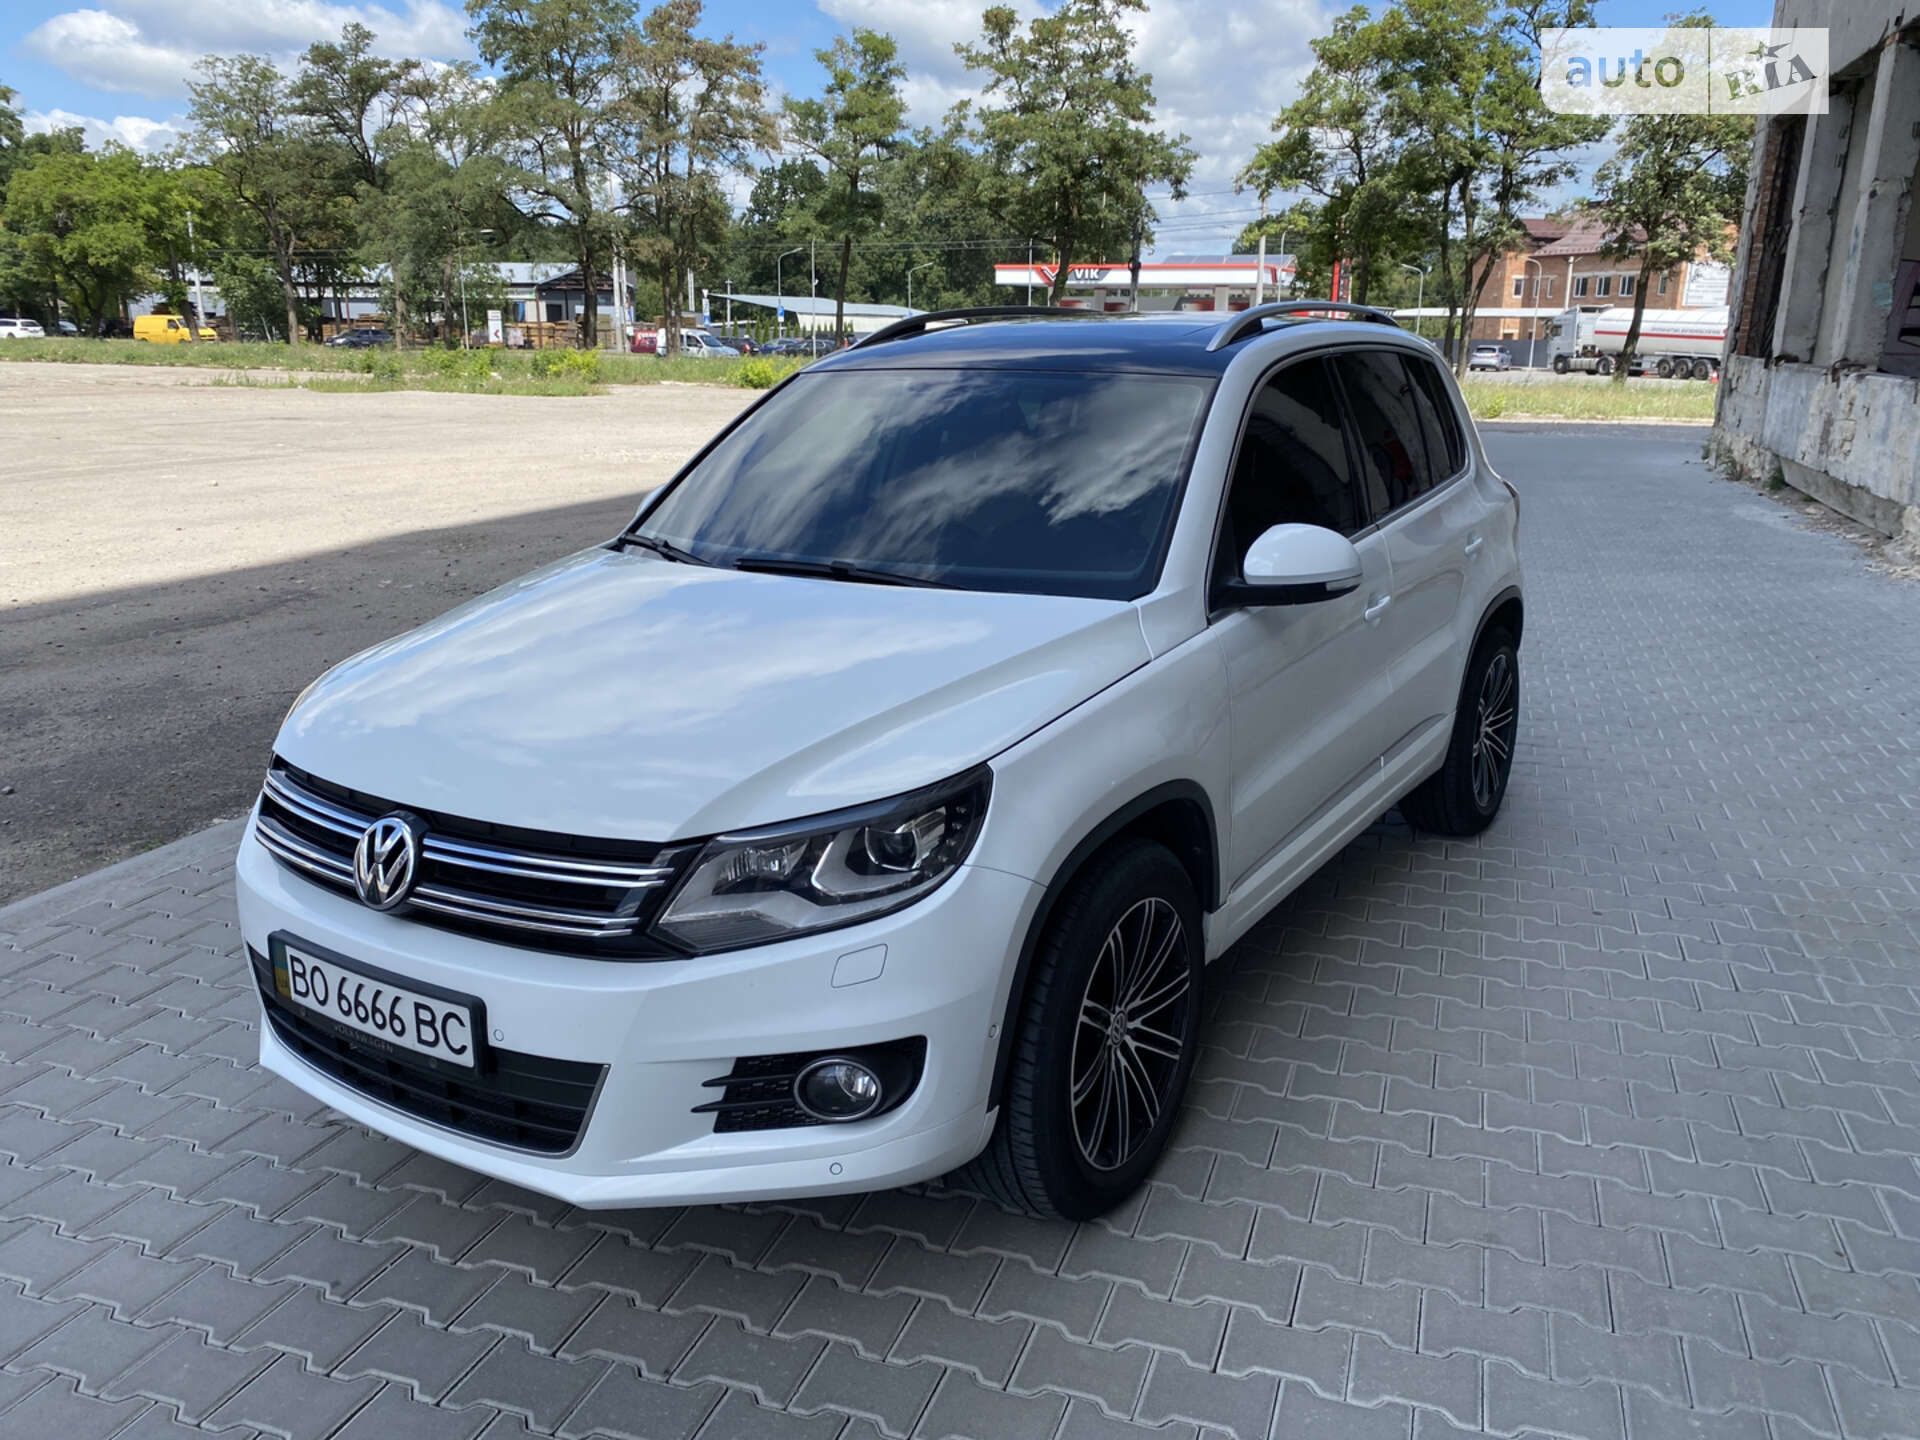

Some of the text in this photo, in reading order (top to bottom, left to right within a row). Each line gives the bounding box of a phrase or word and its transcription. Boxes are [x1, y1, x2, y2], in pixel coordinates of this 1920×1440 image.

[1074, 268, 1099, 279] VIK
[290, 954, 468, 1055] BO 6666 BC
